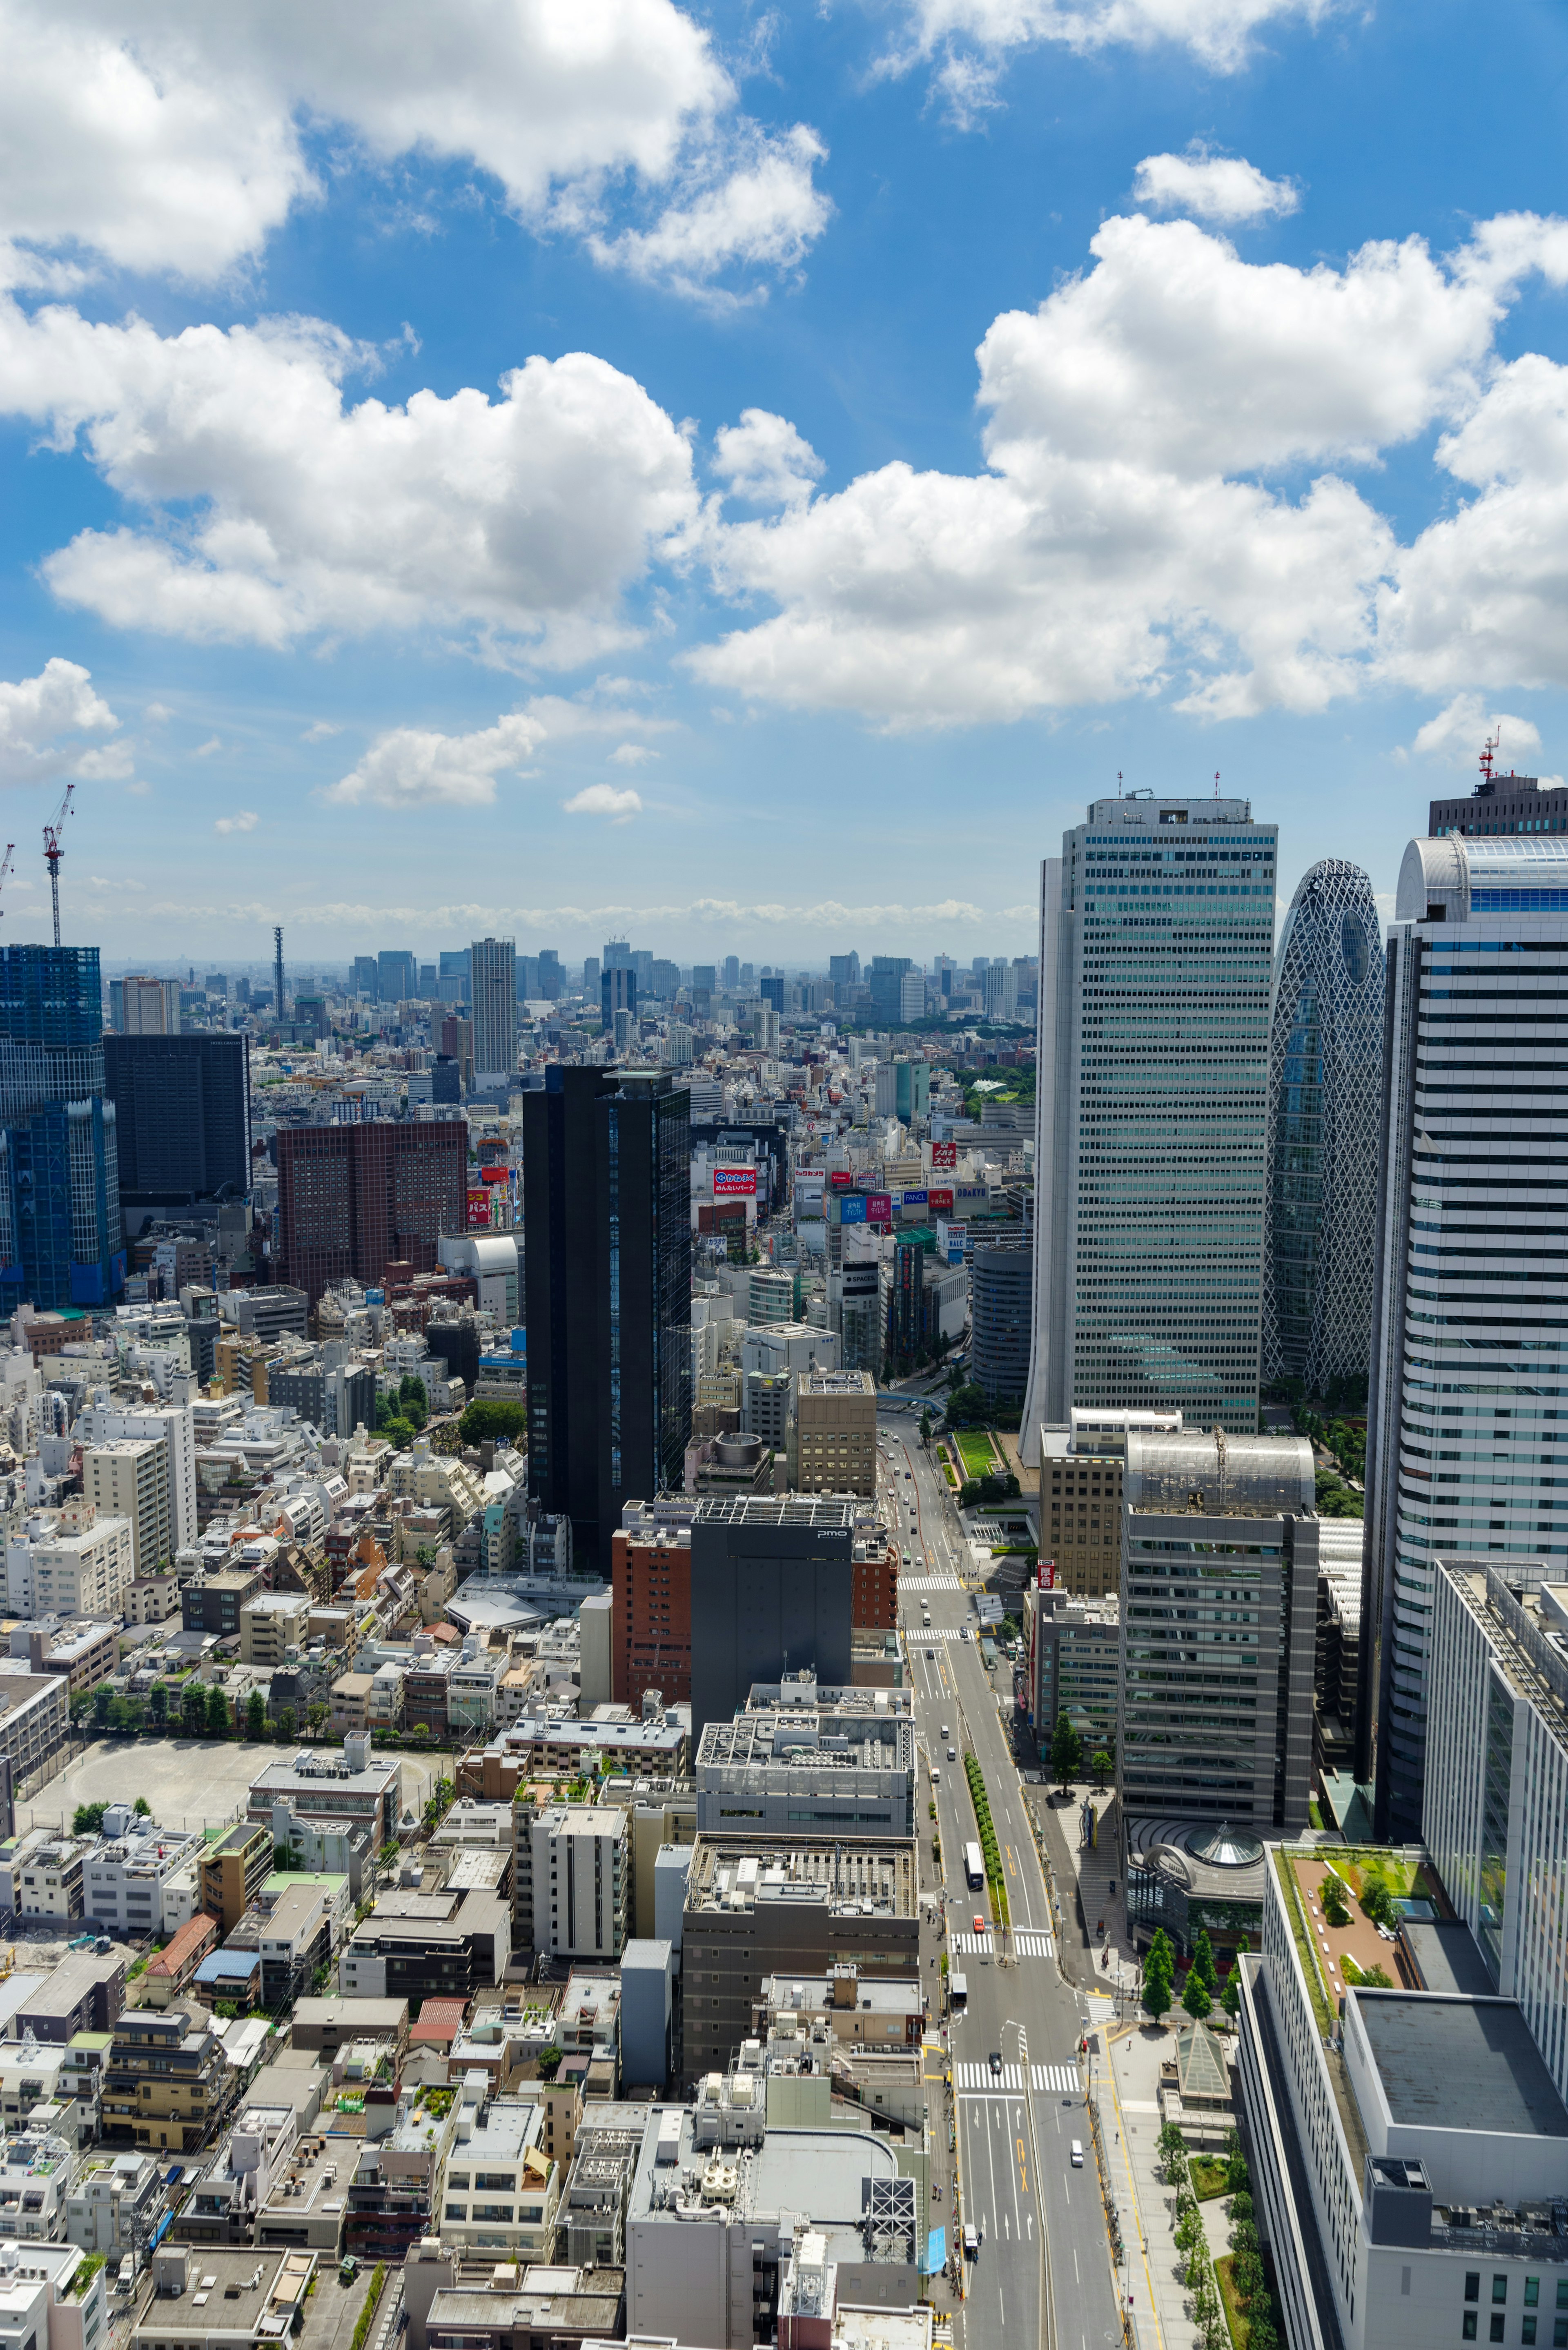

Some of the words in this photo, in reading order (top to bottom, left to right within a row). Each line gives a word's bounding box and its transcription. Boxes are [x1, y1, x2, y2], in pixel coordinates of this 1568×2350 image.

[958, 1187, 985, 1197] ODAKYU
[469, 1202, 487, 1212] パス
[709, 1237, 726, 1245] カラオケ
